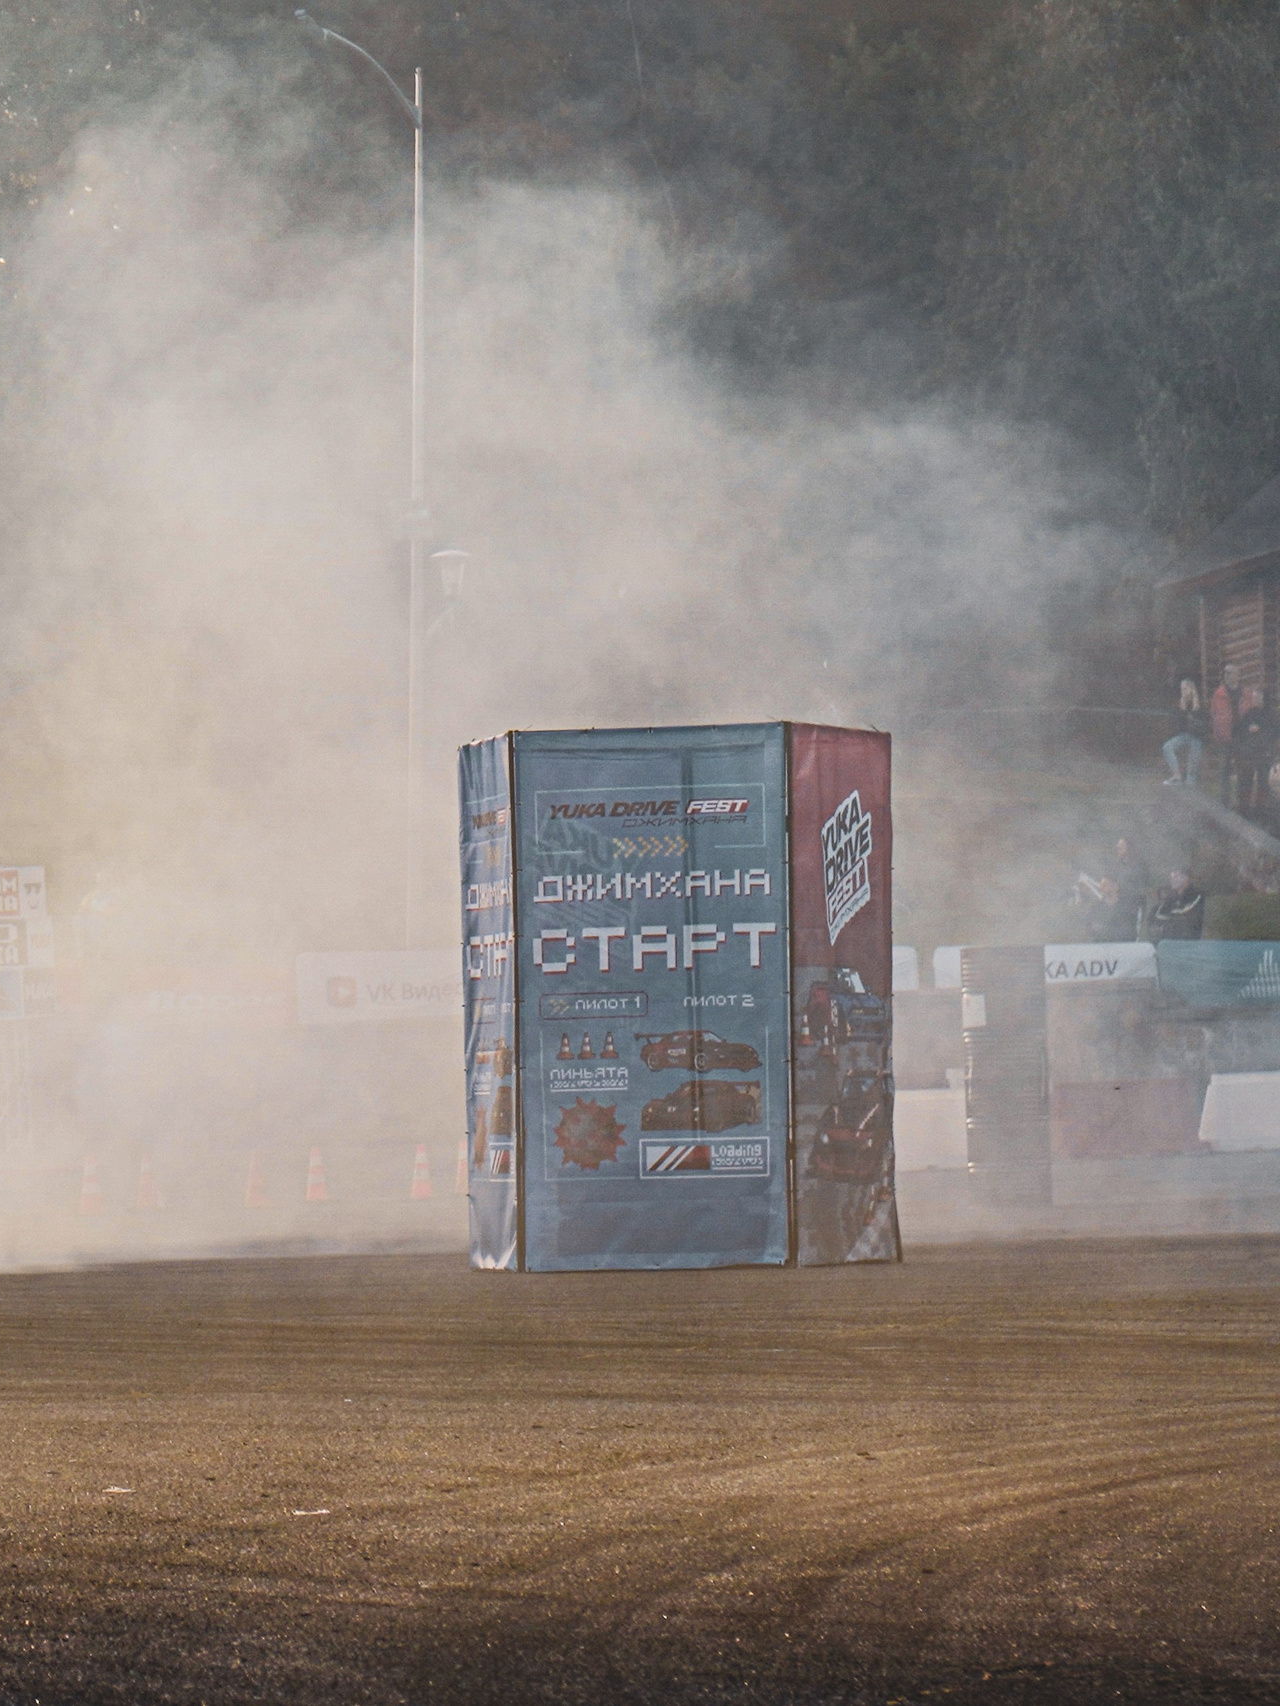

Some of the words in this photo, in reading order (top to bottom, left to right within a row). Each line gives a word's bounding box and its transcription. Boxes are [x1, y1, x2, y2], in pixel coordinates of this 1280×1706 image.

[550, 802, 606, 820] YUKA
[609, 800, 681, 818] DRIVE
[686, 799, 749, 814] FEST
[622, 815, 748, 829] ДЖИМХАНА
[822, 796, 861, 861] YUKA
[825, 818, 870, 896] DRIVE
[533, 868, 771, 903] ДЖИМХАНА
[829, 862, 867, 923] FEST
[532, 922, 777, 974] СТАРТ
[1074, 958, 1119, 978] ADV
[634, 996, 640, 1008] 1
[742, 994, 754, 1007] 2
[550, 1067, 628, 1081] ПИНЬЯТА
[711, 1144, 762, 1158] Loading
